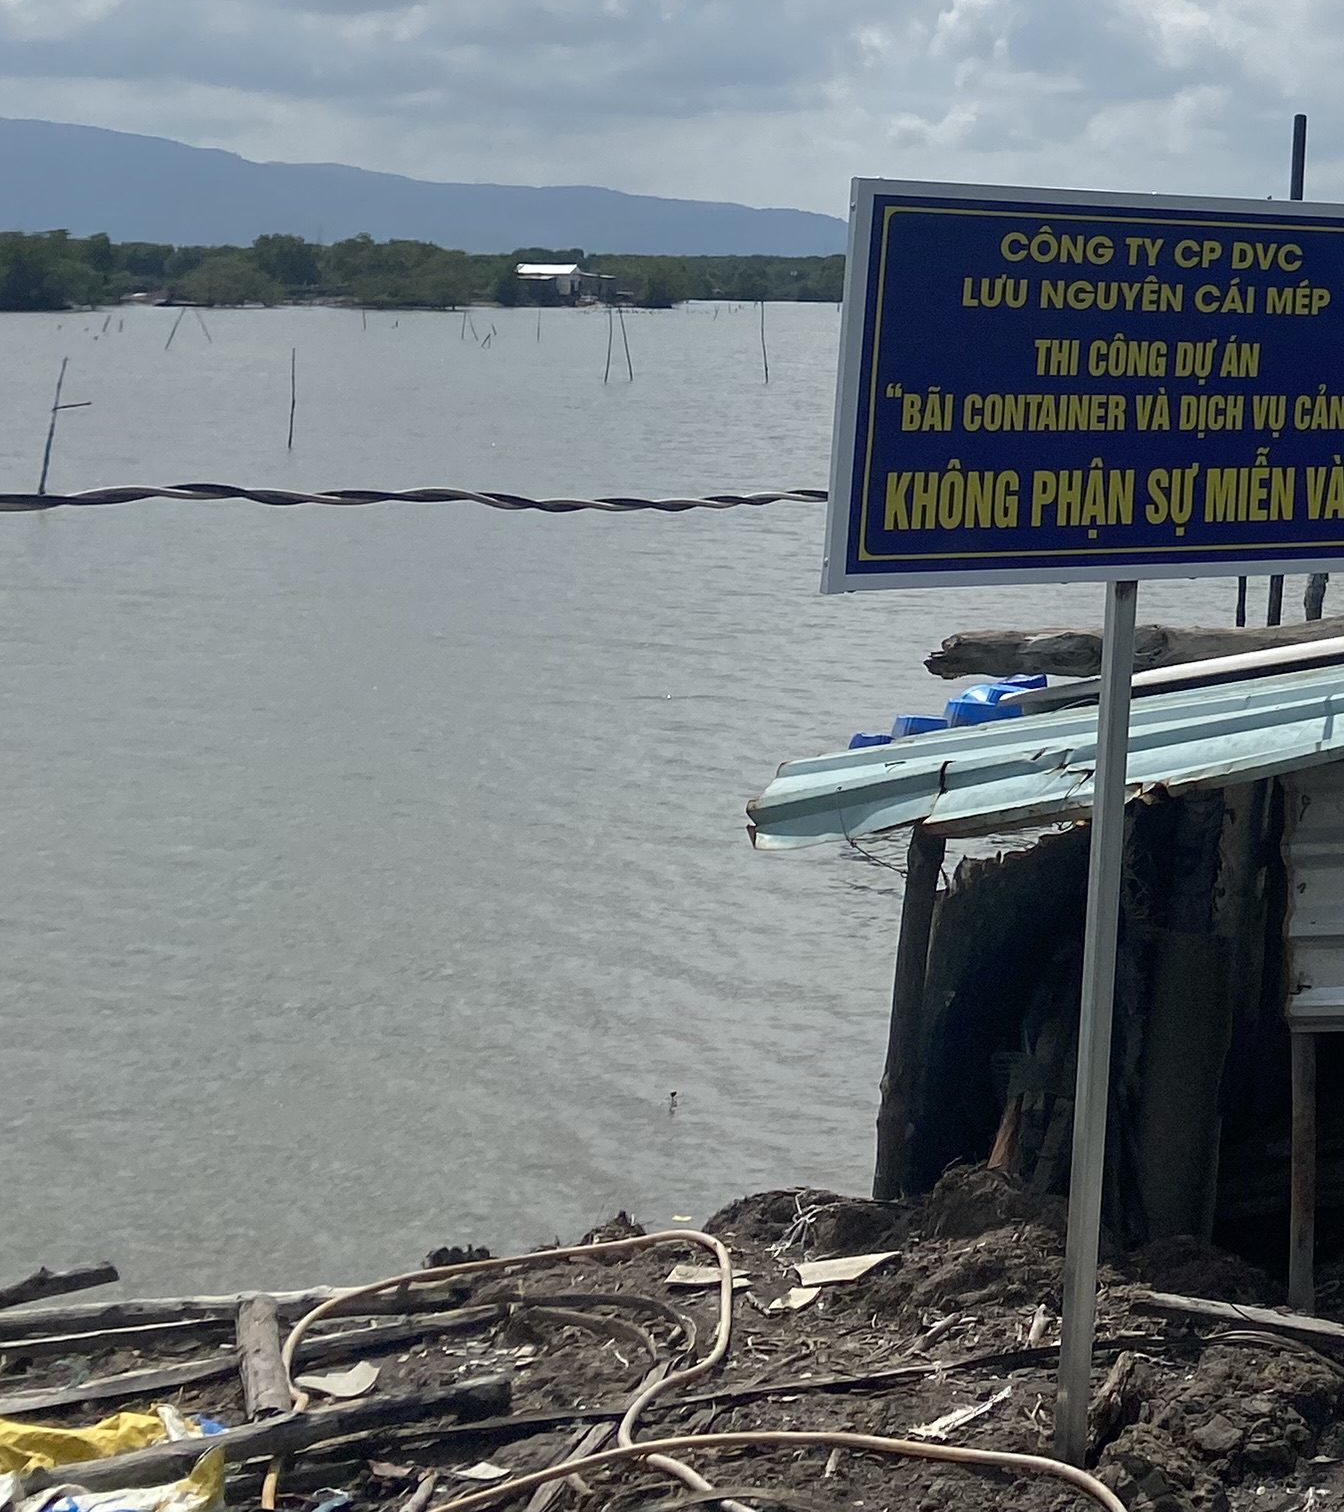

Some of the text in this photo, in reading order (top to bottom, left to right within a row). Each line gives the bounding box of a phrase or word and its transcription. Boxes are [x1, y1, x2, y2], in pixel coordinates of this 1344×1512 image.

[1000, 224, 1303, 272] CÔNG TY CP DVC
[961, 274, 1331, 316] LƯU NGUYÊN CÁI MÉP
[1034, 332, 1261, 386] THI CÔNG DỰ ÁN
[962, 393, 1127, 432] CONTAINER
[1135, 387, 1171, 431] VÀ
[1178, 394, 1245, 439] DỊCH
[1252, 394, 1287, 439] VỤ
[883, 458, 1020, 530] KHÔNG
[1030, 457, 1136, 539] PHẬN
[1144, 462, 1200, 537] SỰ
[1203, 446, 1296, 523] MIỄN
